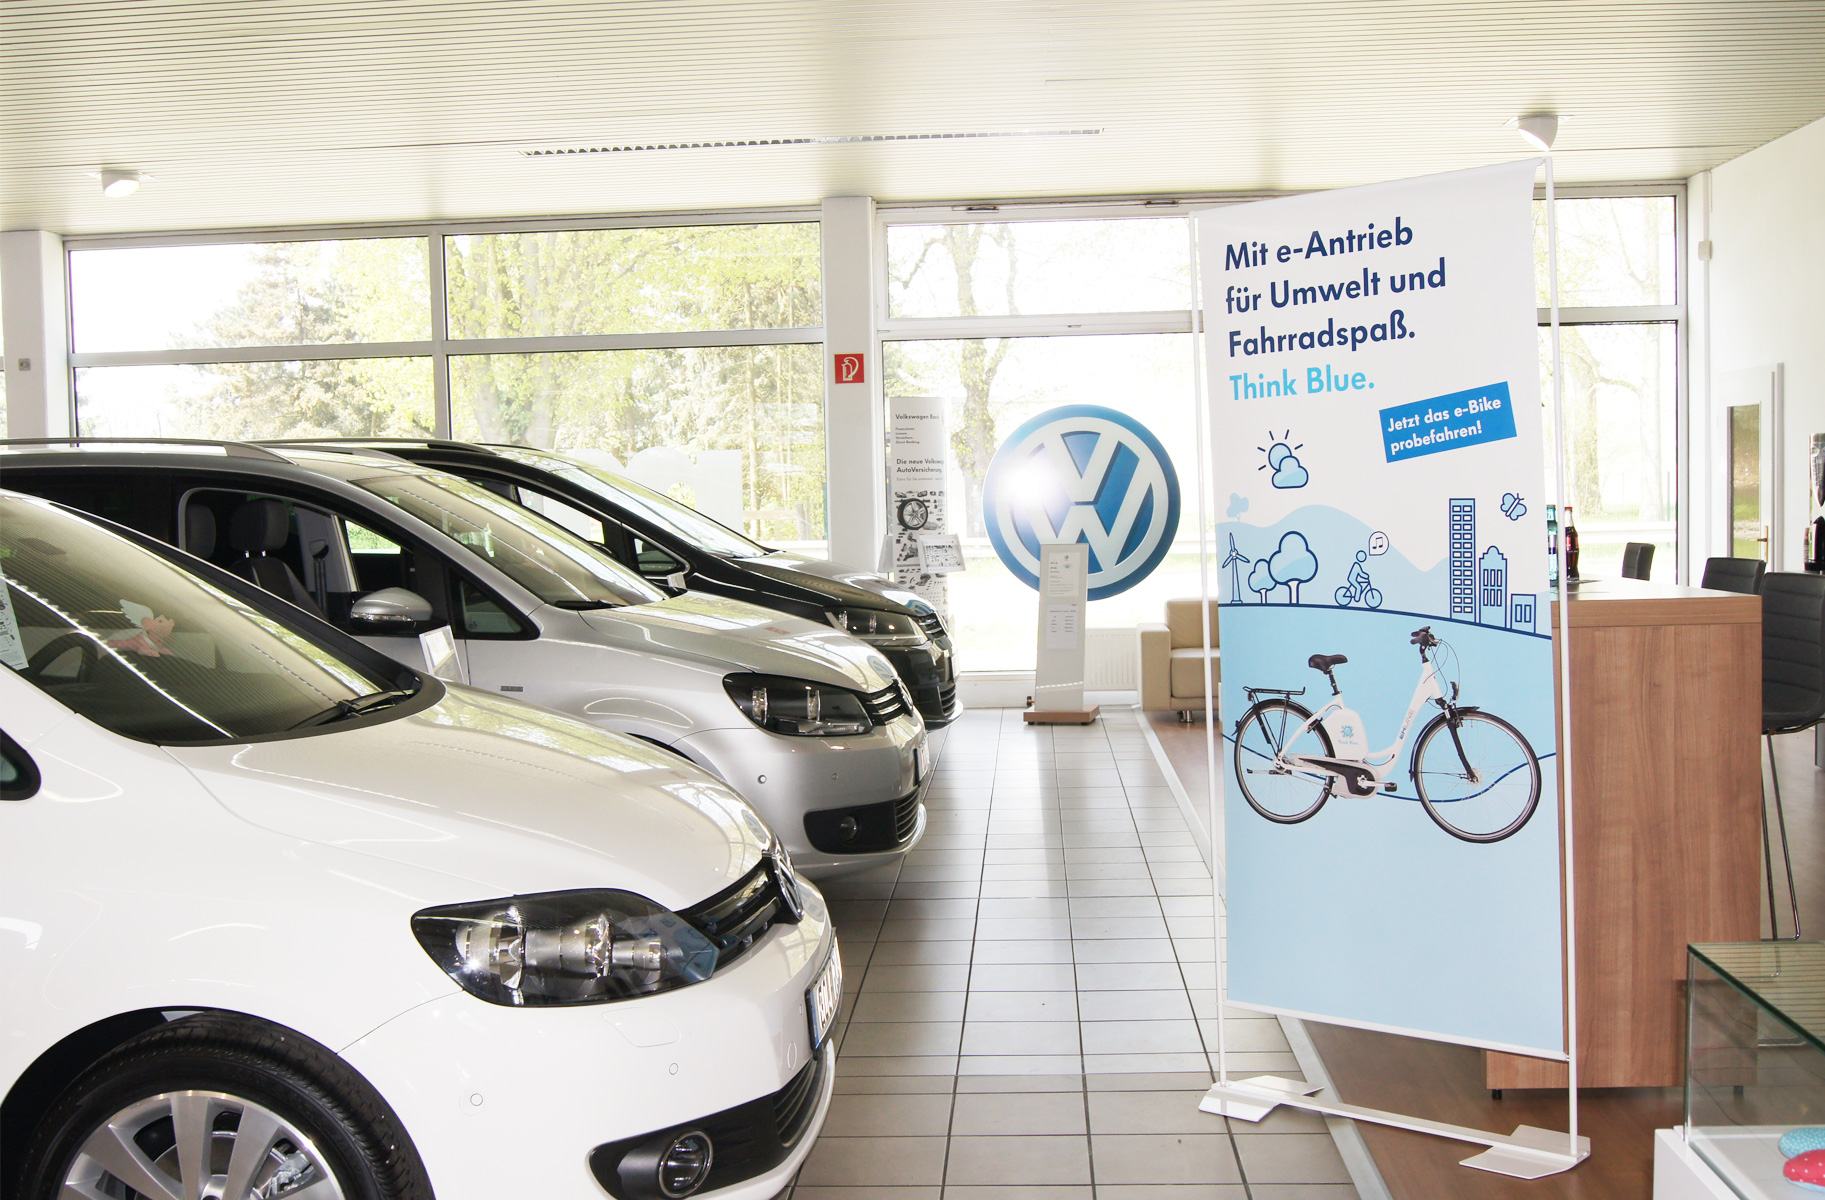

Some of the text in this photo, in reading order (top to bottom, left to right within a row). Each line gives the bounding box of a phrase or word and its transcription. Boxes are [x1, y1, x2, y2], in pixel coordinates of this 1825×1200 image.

[1225, 216, 1413, 271] Mit e-Antrieb
[1226, 257, 1446, 314] für Umwelt und
[1229, 309, 1415, 357] Fahrradspaß.
[1230, 364, 1375, 400] Think Blue.
[1388, 396, 1502, 432] Jetzt das e-Bike
[1390, 420, 1483, 455] probefahren!
